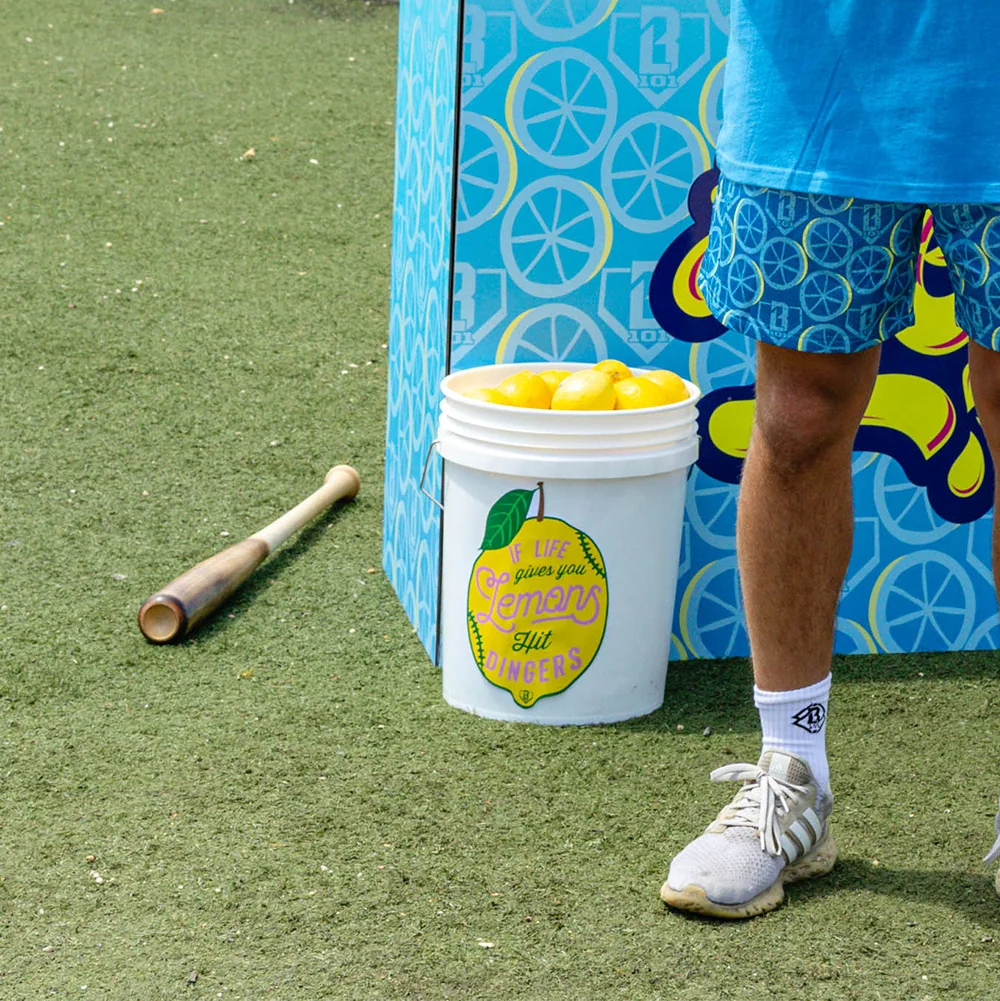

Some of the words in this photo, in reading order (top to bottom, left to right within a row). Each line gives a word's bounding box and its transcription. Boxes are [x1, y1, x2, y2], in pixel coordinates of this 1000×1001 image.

[462, 75, 484, 87] 01
[638, 75, 679, 88] 101
[451, 331, 475, 344] 01
[509, 543, 522, 564] IF
[535, 539, 571, 559] LIFE
[514, 566, 553, 584] gives
[557, 563, 586, 581] you
[475, 566, 601, 634] Lemons
[512, 630, 553, 654] Hit
[485, 647, 582, 684] DINGERS
